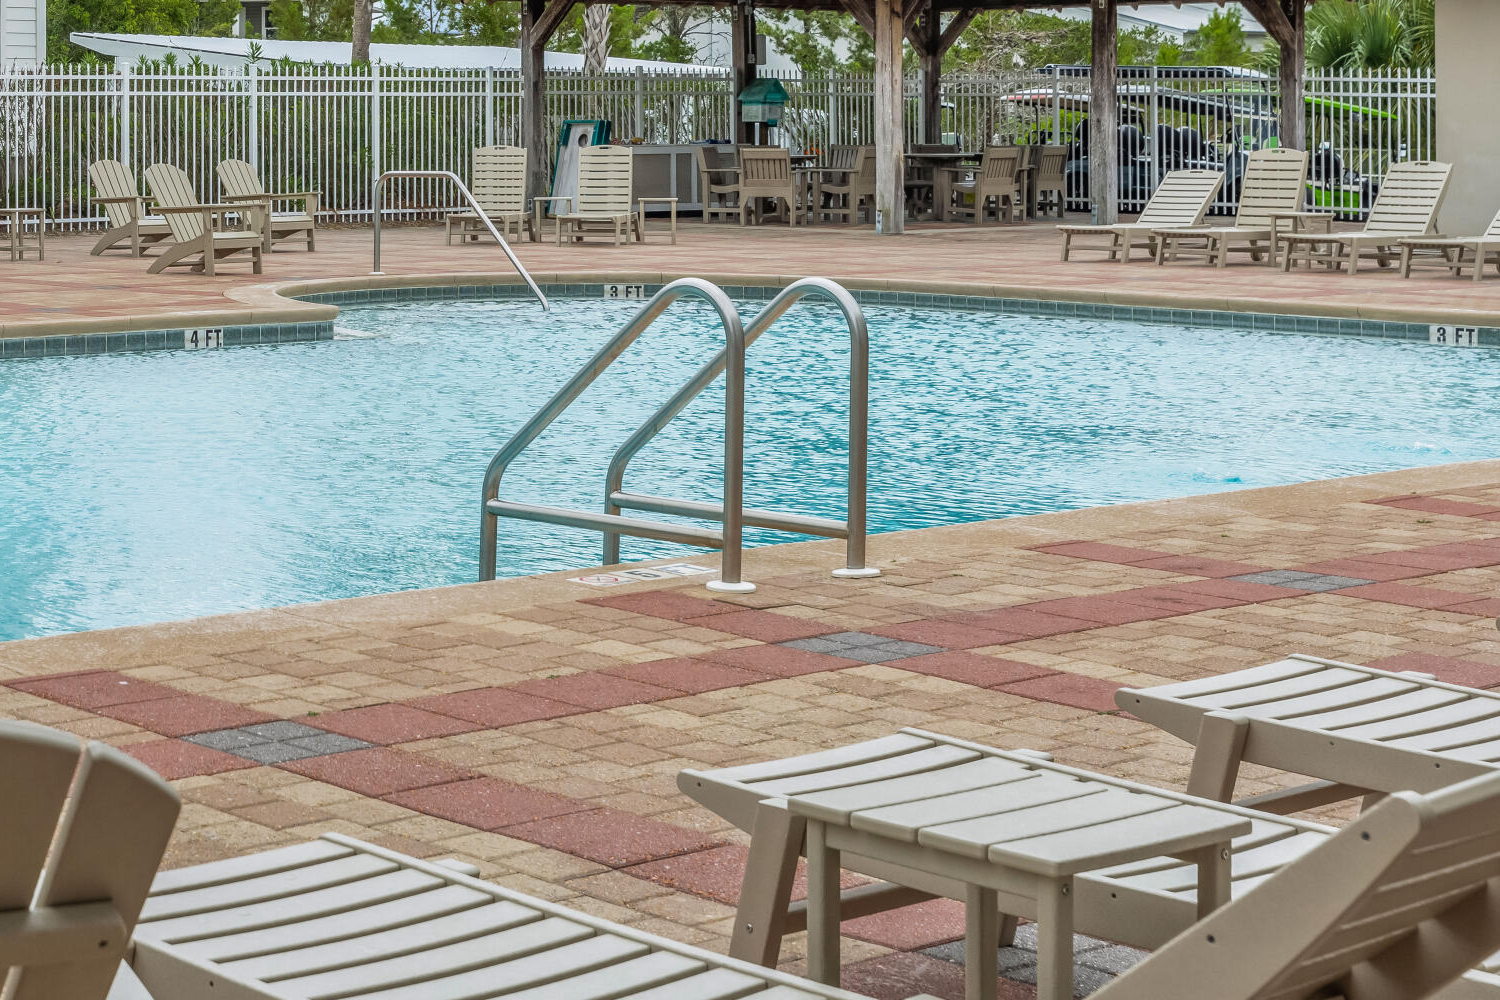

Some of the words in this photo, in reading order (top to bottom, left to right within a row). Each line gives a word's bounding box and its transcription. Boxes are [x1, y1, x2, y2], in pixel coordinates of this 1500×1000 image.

[610, 285, 619, 297] 3
[625, 285, 642, 297] FT
[190, 330, 199, 348] 4
[1437, 326, 1446, 344] 3
[1455, 327, 1476, 345] FT
